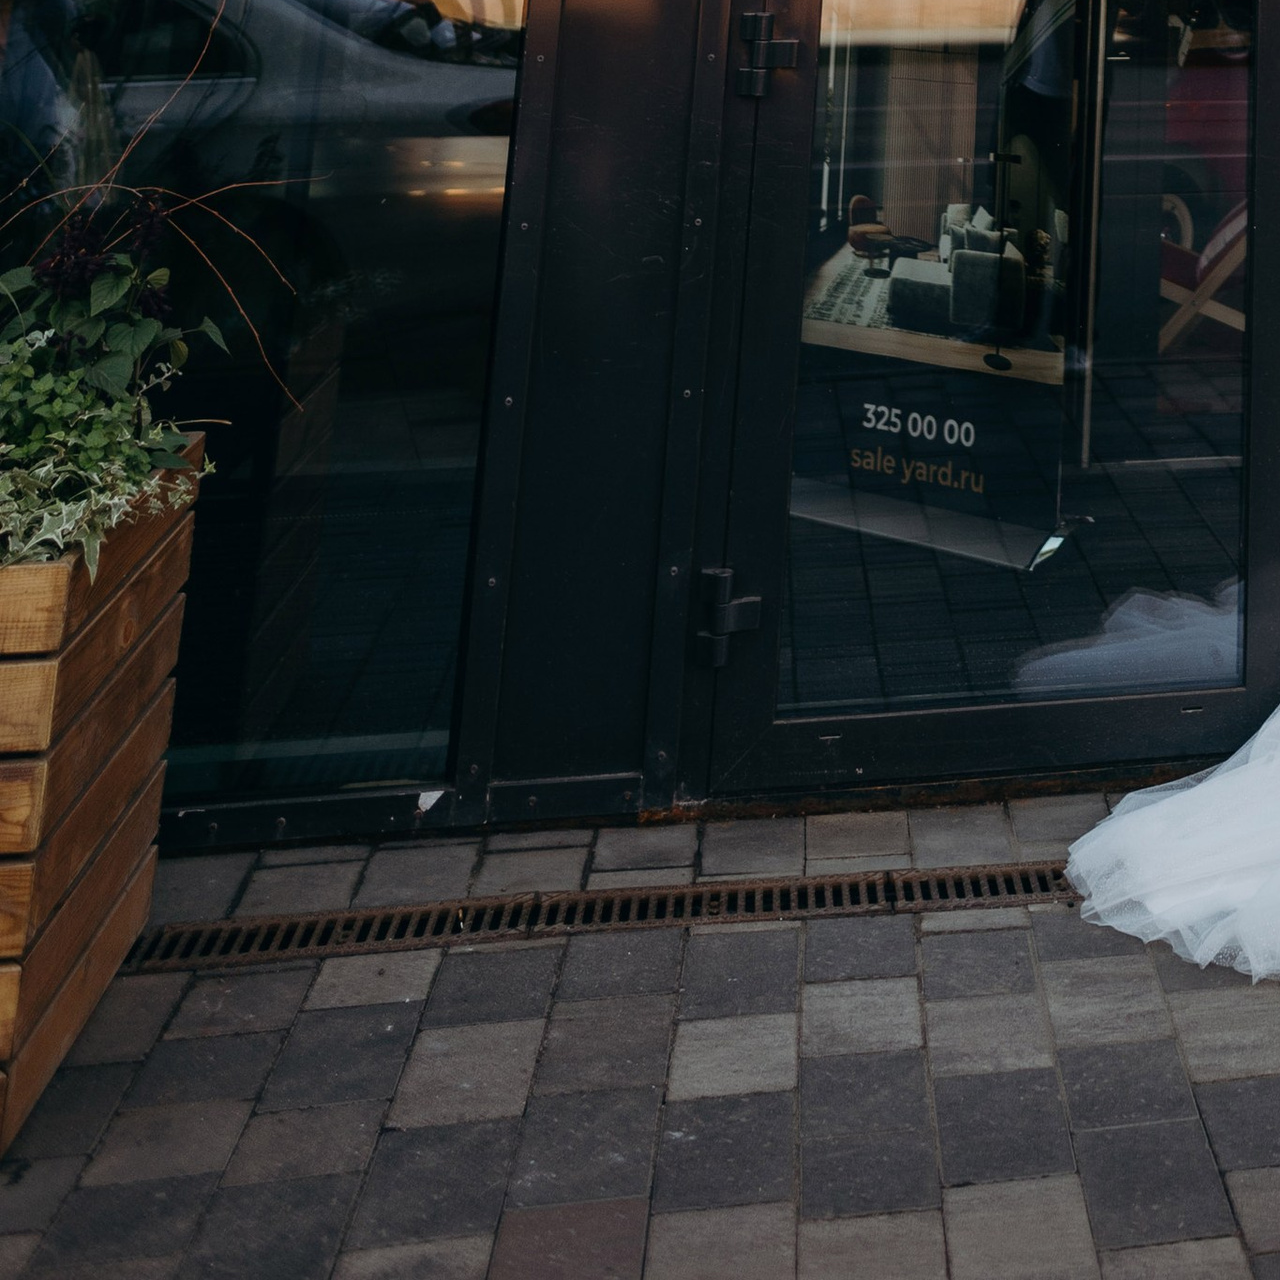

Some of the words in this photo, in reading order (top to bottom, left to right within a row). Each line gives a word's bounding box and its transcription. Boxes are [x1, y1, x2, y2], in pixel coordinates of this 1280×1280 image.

[862, 403, 902, 434] 325
[907, 412, 938, 440] 00
[944, 419, 976, 447] 00
[850, 446, 896, 474] sale
[901, 457, 984, 493] yard.ru
